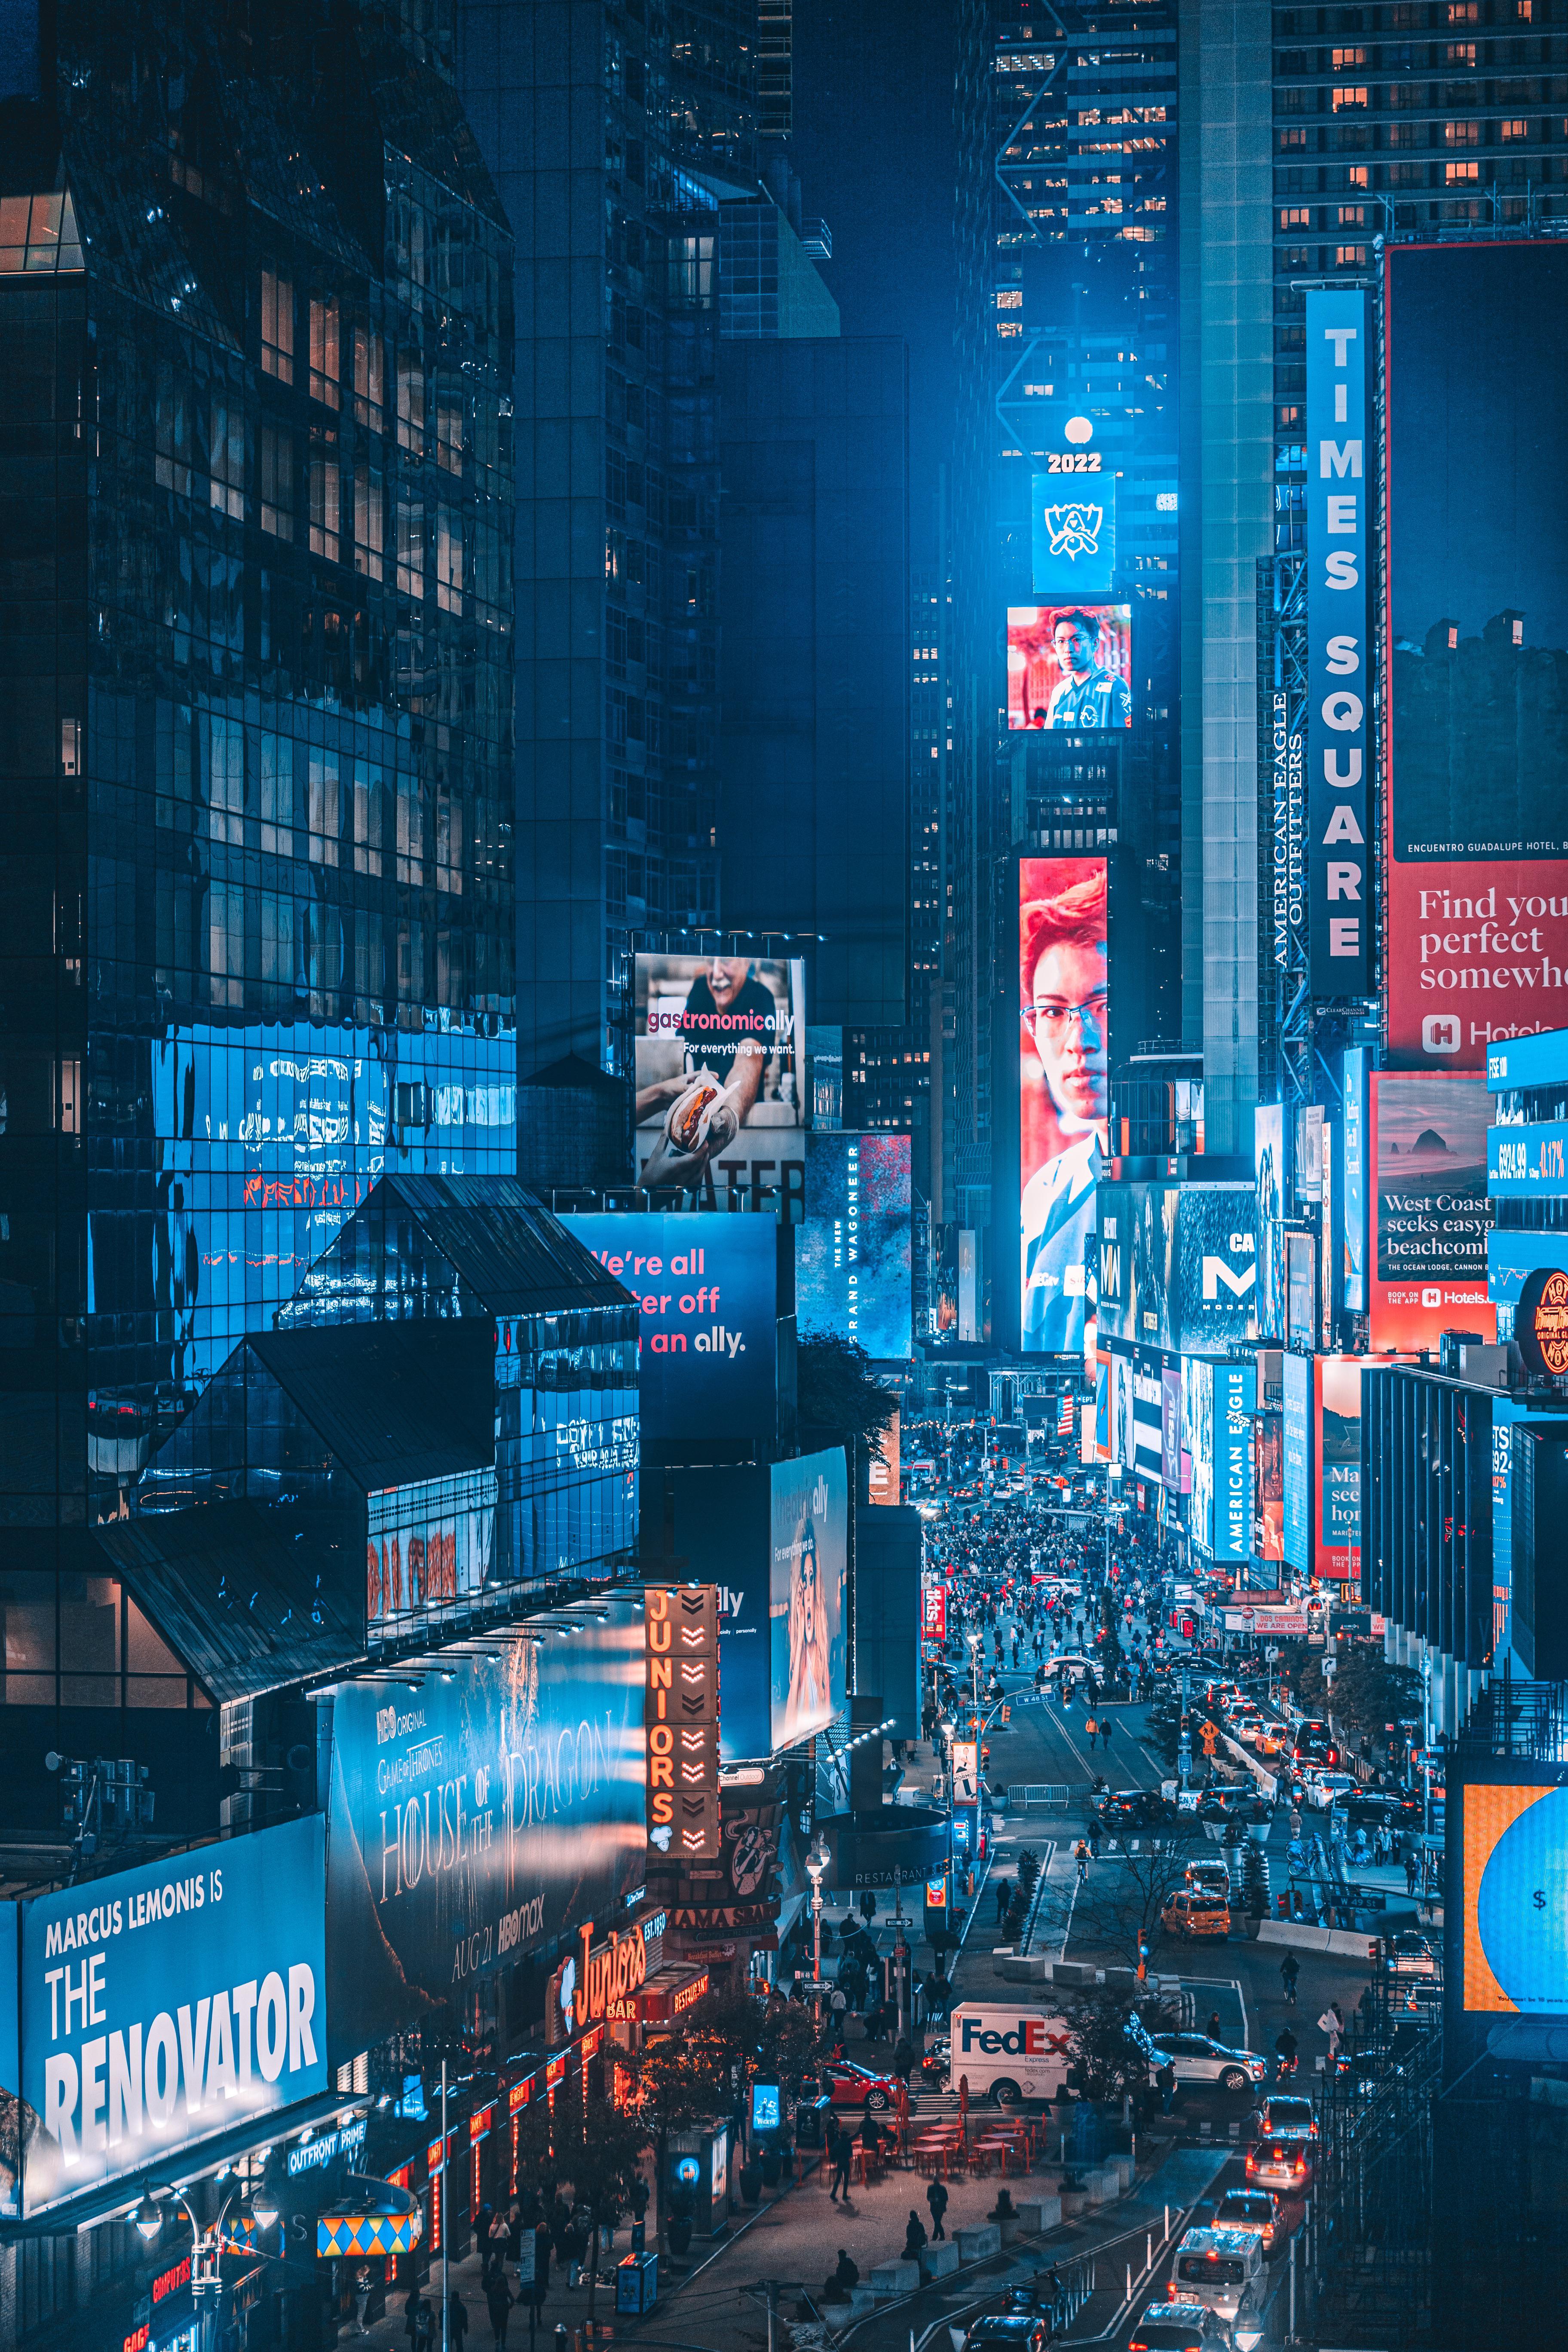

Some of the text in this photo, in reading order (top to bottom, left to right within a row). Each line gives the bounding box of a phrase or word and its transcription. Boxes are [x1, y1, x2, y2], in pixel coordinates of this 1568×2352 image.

[1048, 453, 1101, 473] 2022
[1320, 329, 1364, 956] TIMES SQUARE
[1274, 692, 1287, 968] AMERICAN EAGLE
[1289, 734, 1302, 925] OUTFITTERS
[1408, 841, 1559, 853] ENCUENTRO GUADALUPE HOTEL,
[1418, 887, 1497, 919] Find
[1420, 921, 1544, 963] perfect
[1420, 956, 1568, 989] somewh
[648, 1008, 794, 1035] gastronomically
[1470, 1021, 1554, 1045] Hotel
[683, 1042, 795, 1056] For everything we want.
[1499, 1142, 1526, 1179] 6924.99
[1384, 1194, 1491, 1211] West Coast
[1387, 1214, 1438, 1232] seeks
[671, 1248, 704, 1276] all
[848, 1147, 858, 1344] GRAND WAGONEER
[679, 1286, 720, 1314] off
[651, 1326, 746, 1358] an ally.
[1537, 1331, 1560, 1340] ORIGINAL
[1492, 1425, 1511, 1450] TS
[1229, 1446, 1243, 1553] AMERICAN
[782, 1539, 802, 1560] everything
[802, 1540, 807, 1552] we
[926, 1589, 942, 1622] tkts
[377, 1705, 427, 1745] HBO ORIGINAL
[649, 1590, 674, 1823] JUNIORS
[377, 1756, 404, 1795] GAME
[406, 1735, 443, 1782] THRONES
[503, 1709, 612, 1834] DRAGON
[954, 1772, 977, 1782] MORMON
[475, 1764, 490, 1807] OF
[380, 1774, 467, 1904] HOUSE
[470, 1809, 493, 1856] THE
[856, 1868, 925, 1884] RESTAURANT
[45, 1869, 223, 1958] MARCUS LEMONIS IS
[1533, 1890, 1547, 1911] $
[452, 1924, 493, 1982] AUG 21
[576, 1921, 646, 2027] Junior's
[45, 1952, 106, 2040] THE
[606, 2000, 636, 2019] BAR
[674, 1974, 709, 2015] RESTAURANT
[962, 2018, 1072, 2056] FedEx
[45, 1963, 318, 2168] RENOVATOR
[289, 2127, 364, 2173] OUTFRONT PRIME
